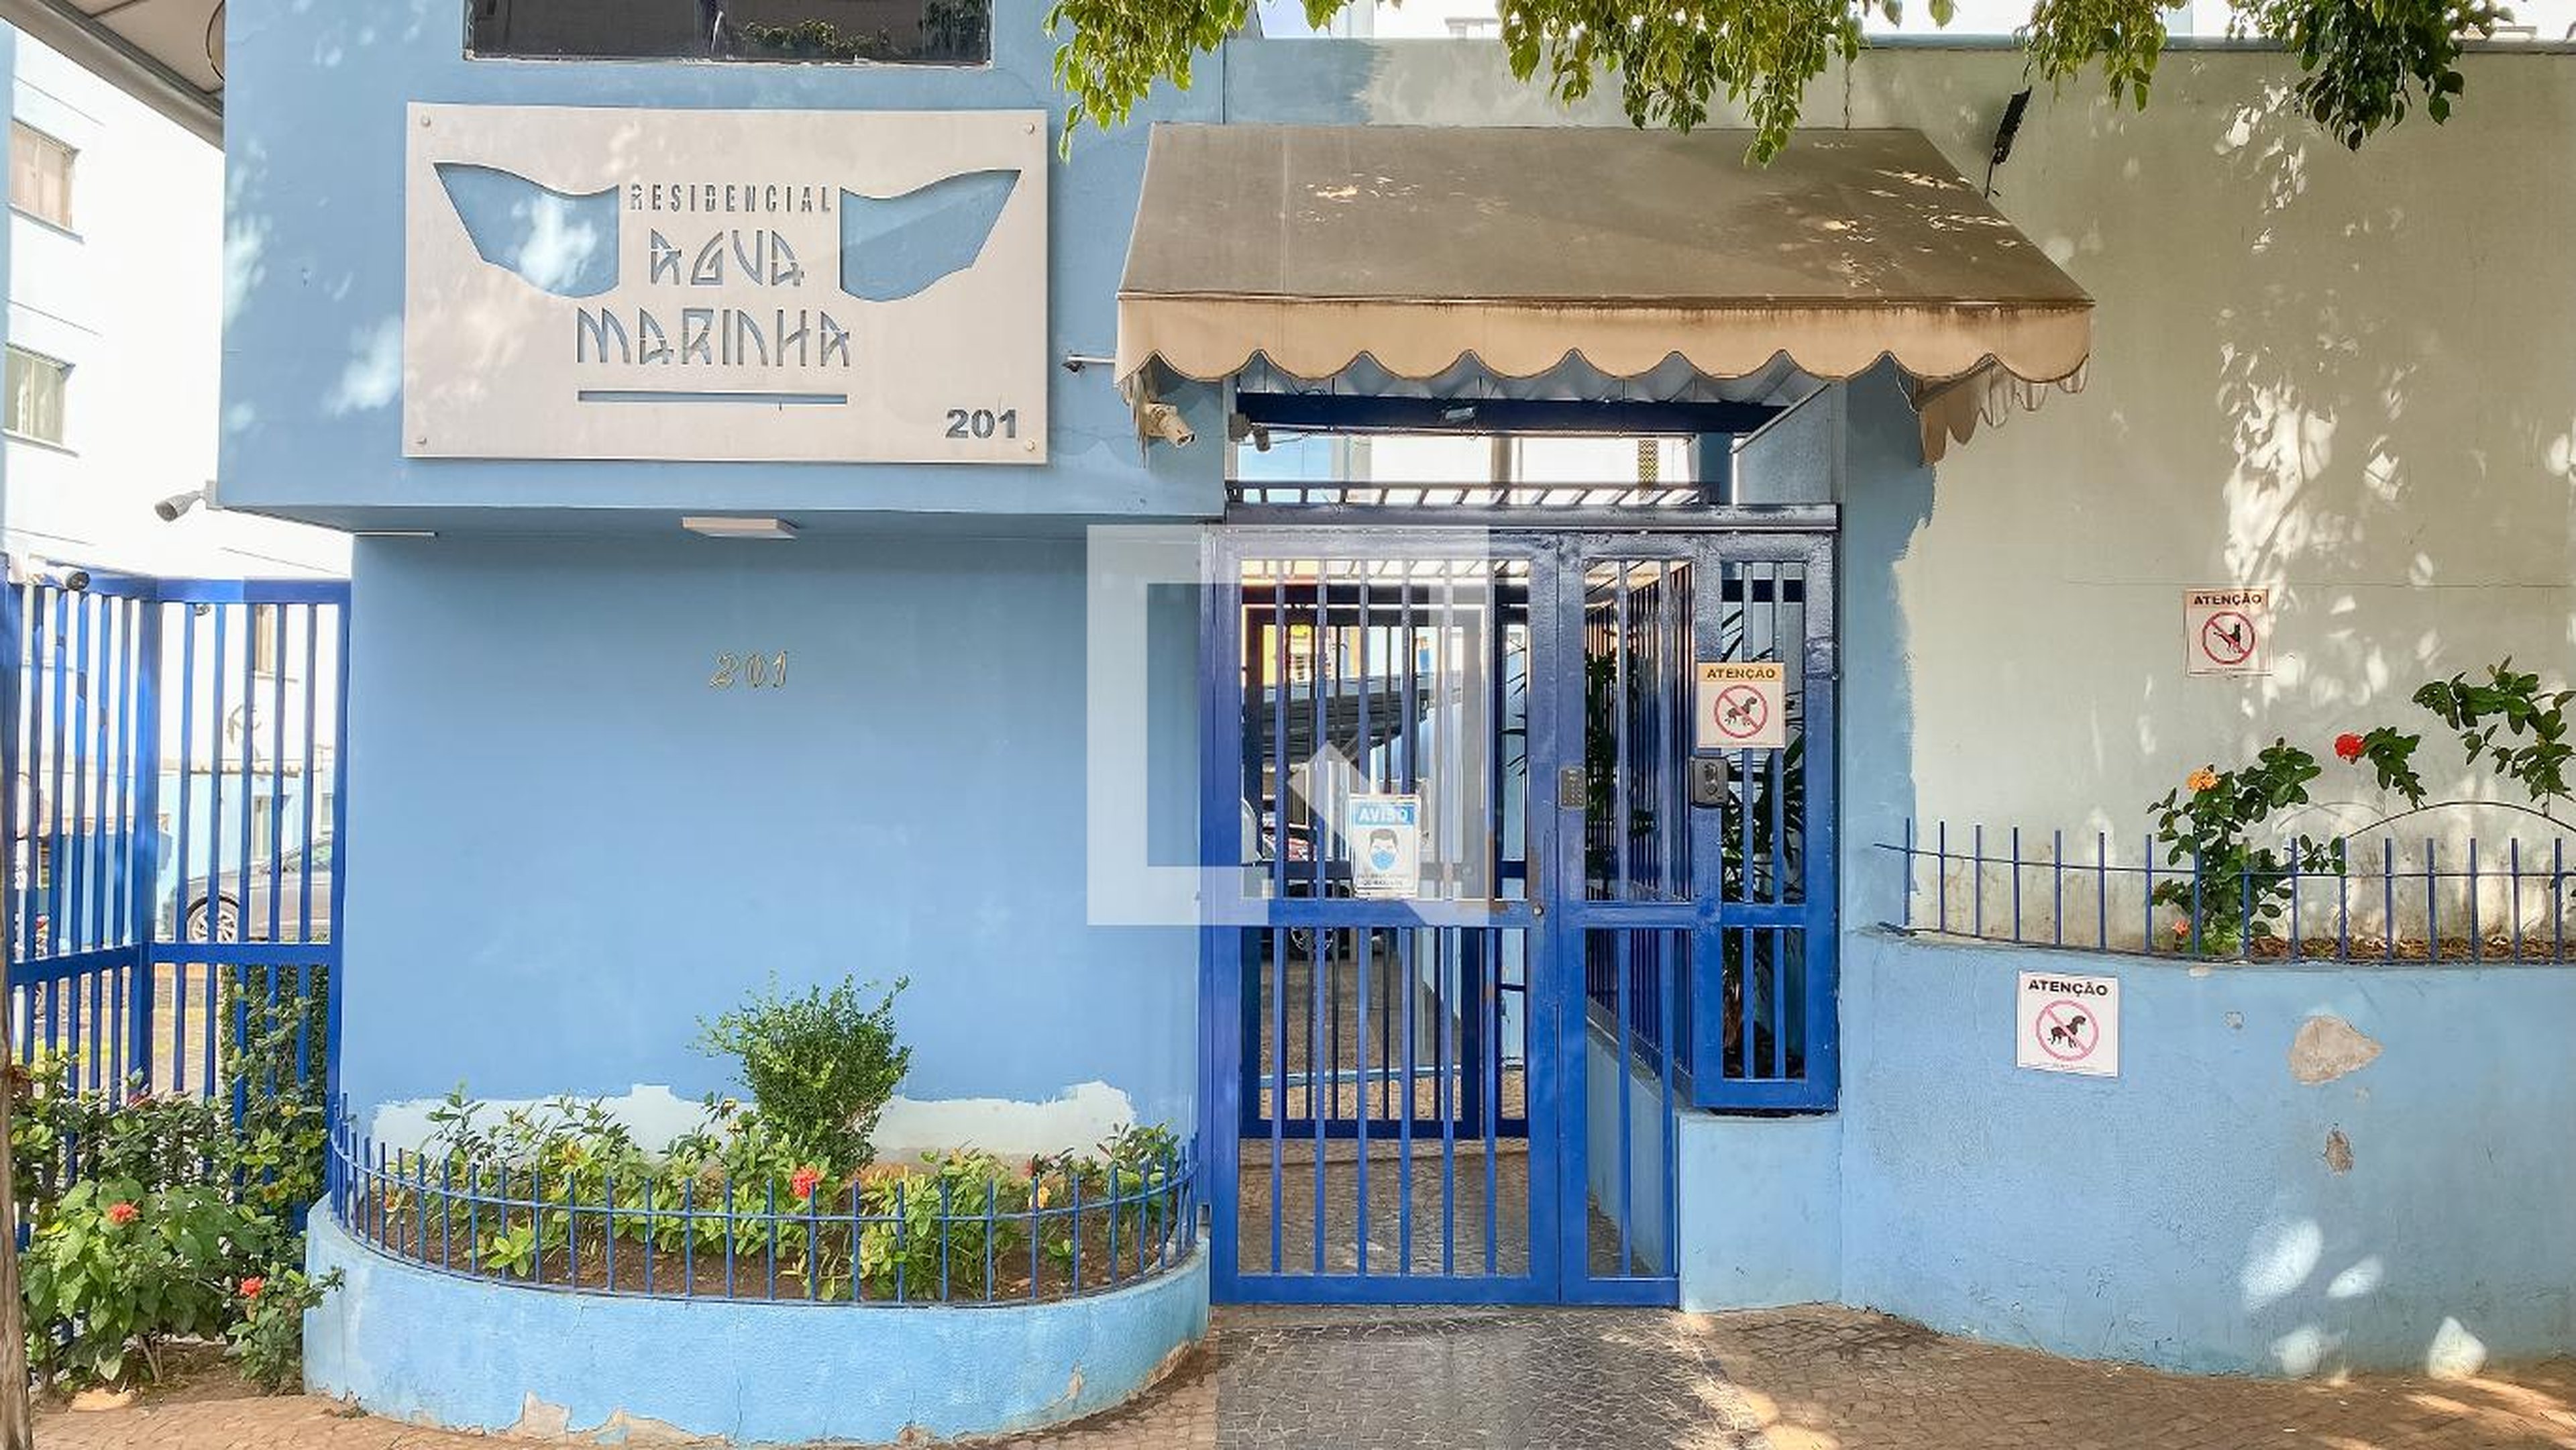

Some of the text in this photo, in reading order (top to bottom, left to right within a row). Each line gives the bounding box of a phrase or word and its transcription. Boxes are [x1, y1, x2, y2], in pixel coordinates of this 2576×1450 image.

[630, 184, 832, 213] RESIDENCIAL
[577, 307, 851, 368] MARINHA
[945, 408, 1018, 439] 201
[2194, 592, 2262, 605] ATENÇÃO
[709, 650, 787, 688] 201
[2028, 979, 2108, 997] ATENÇÃO
